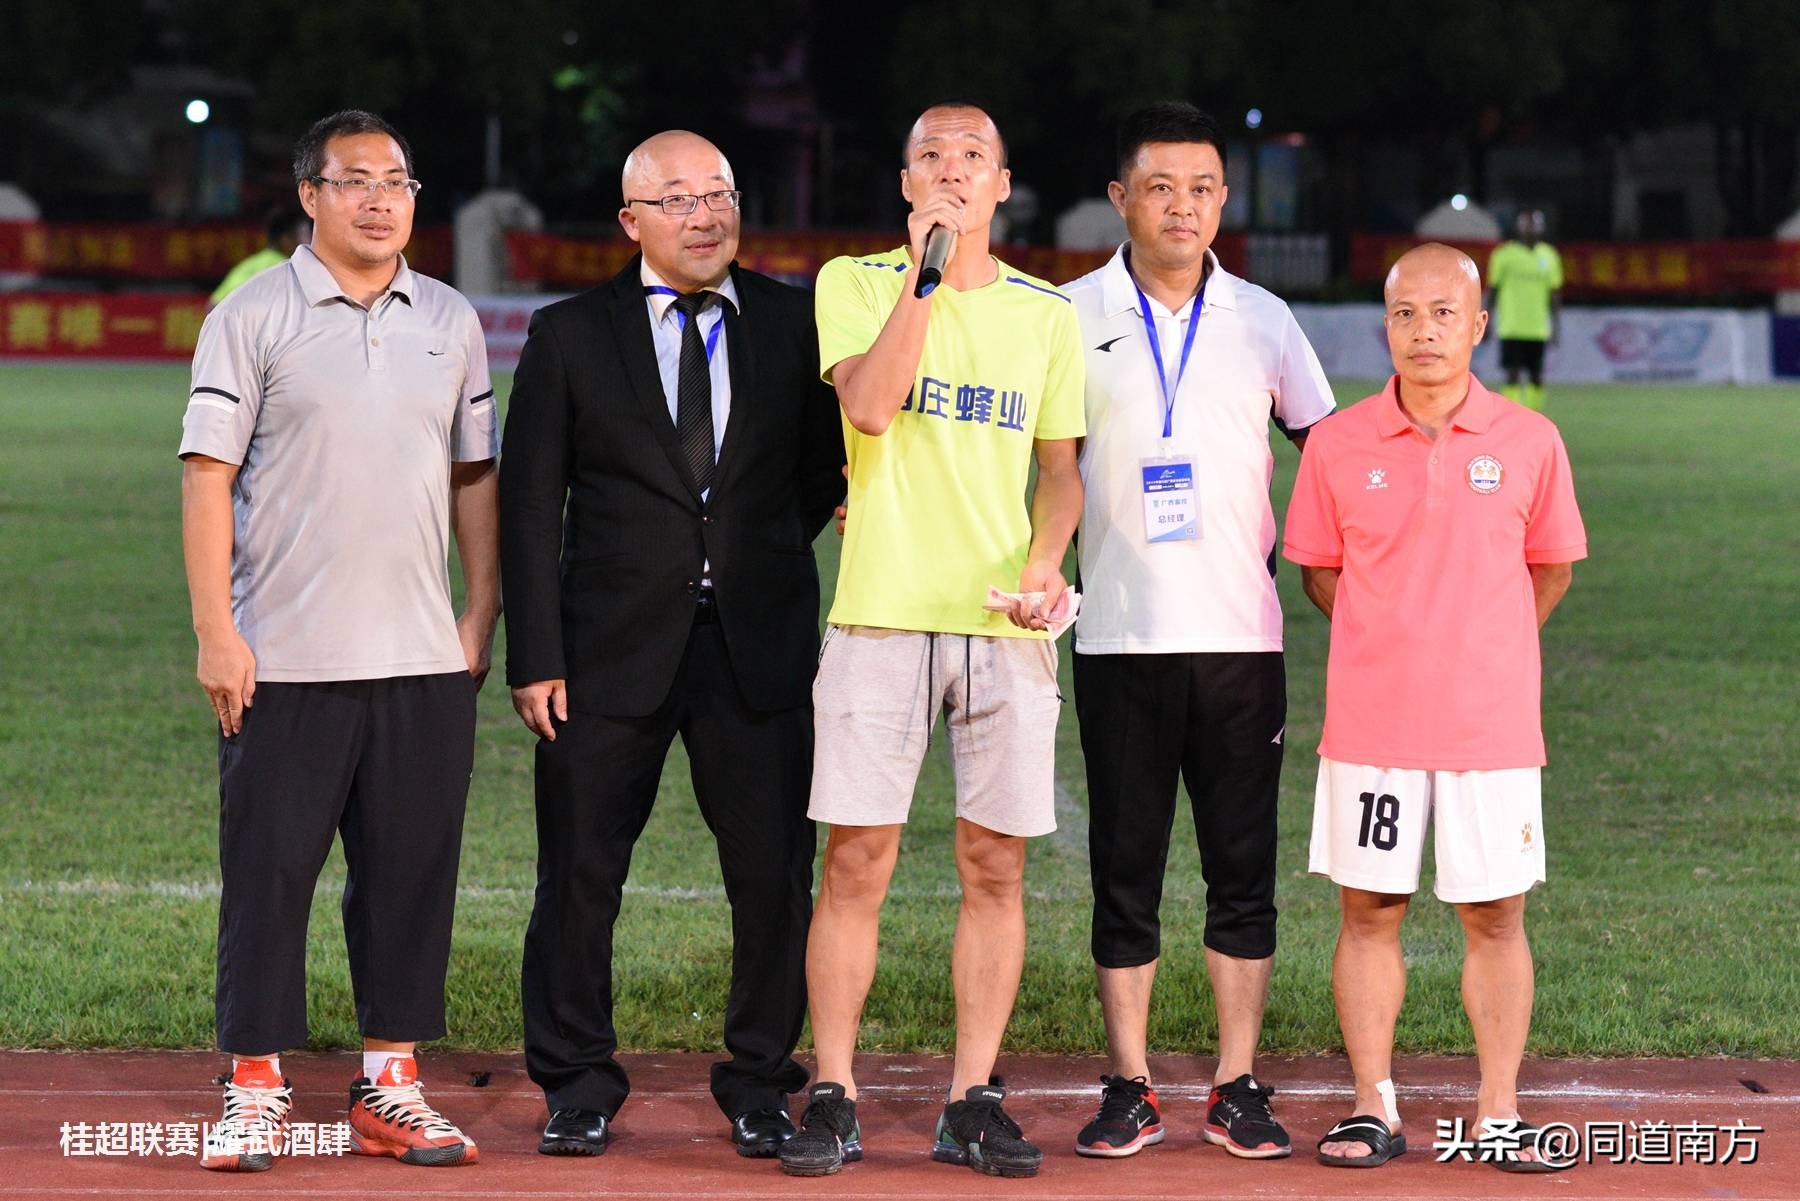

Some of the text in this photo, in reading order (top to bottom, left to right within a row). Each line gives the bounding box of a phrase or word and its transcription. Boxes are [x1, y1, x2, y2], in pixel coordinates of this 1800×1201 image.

[901, 376, 1027, 432] 庄蜂业
[1358, 791, 1400, 851] 18
